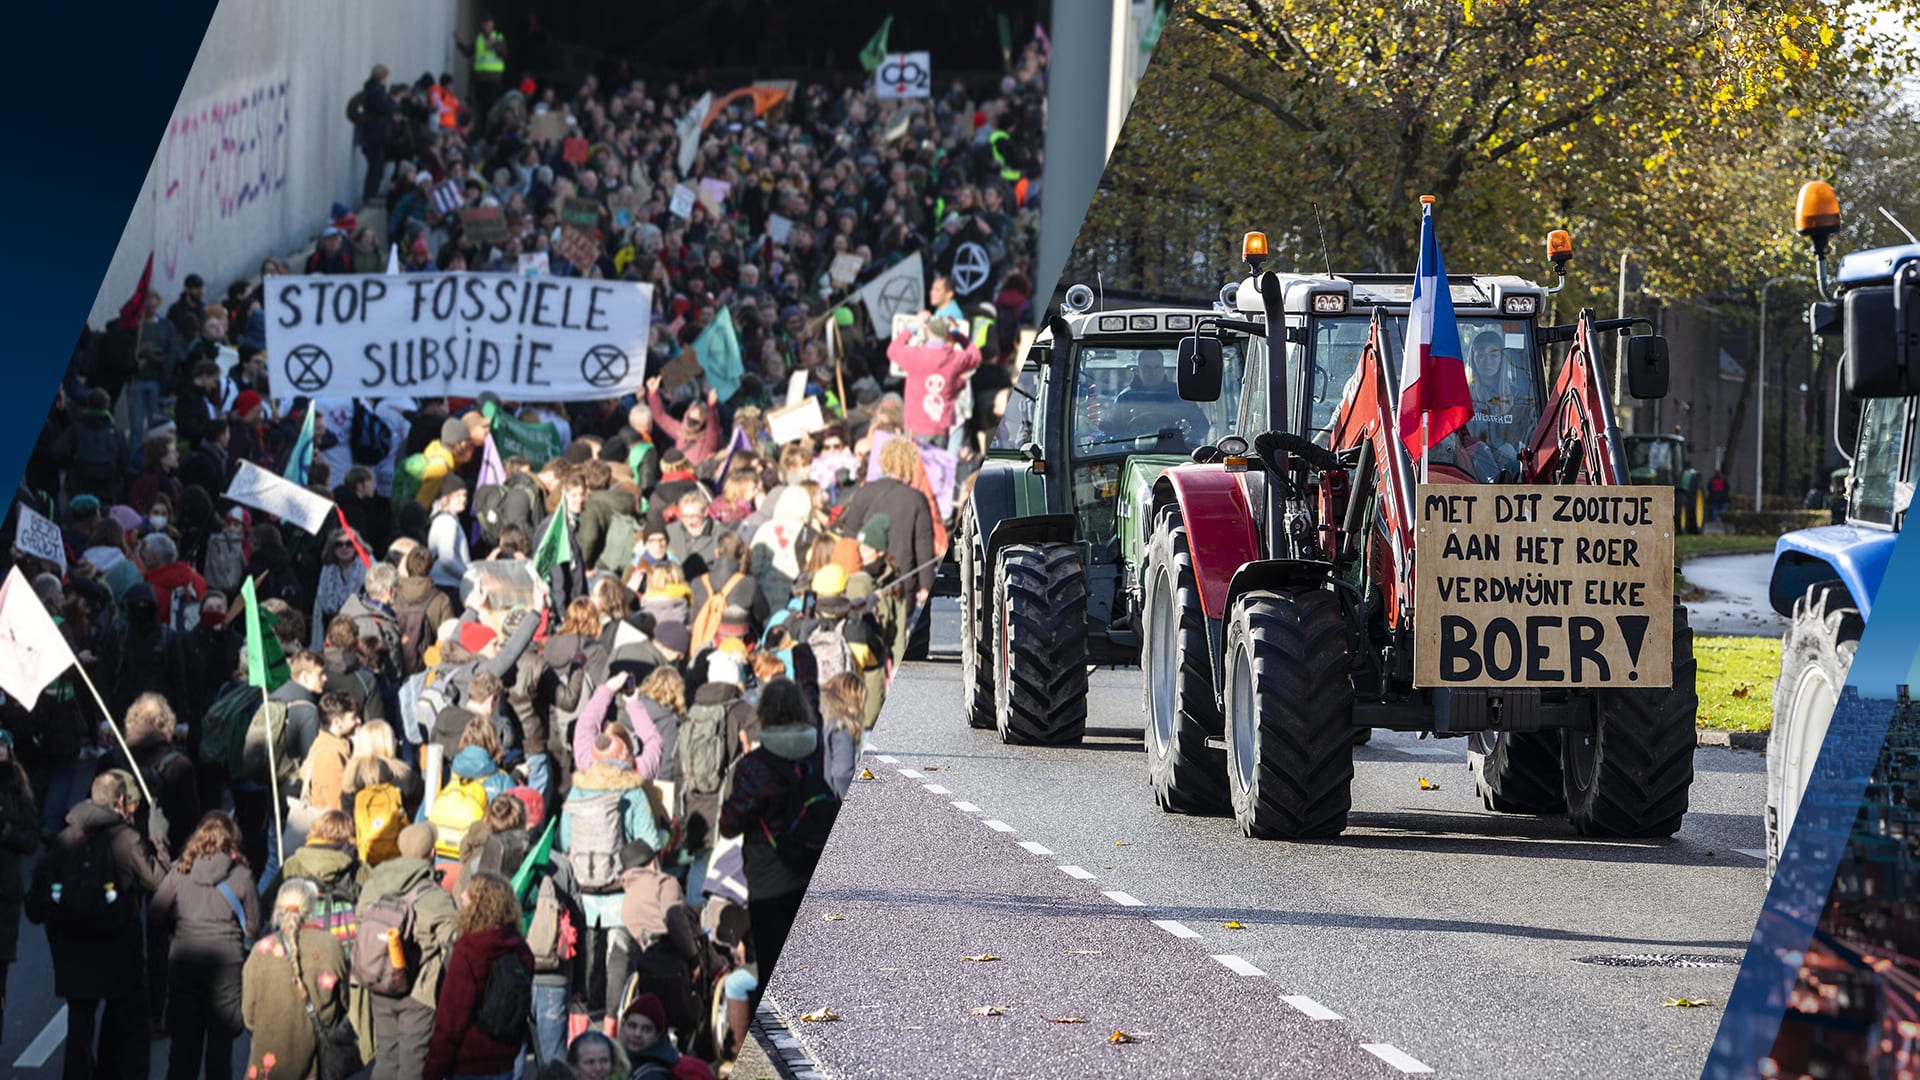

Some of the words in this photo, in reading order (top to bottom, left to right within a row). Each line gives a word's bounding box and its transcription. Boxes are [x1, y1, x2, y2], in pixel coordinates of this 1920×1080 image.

[278, 279, 387, 328] STOP
[407, 275, 614, 331] FOSSIELE
[1425, 494, 1477, 523] MET
[1495, 493, 1542, 523] DIT
[1552, 495, 1653, 526] ZOOITJE
[1442, 533, 1500, 561] AAN
[1516, 536, 1564, 565] HET
[1576, 537, 1640, 567] ROER
[1585, 580, 1645, 607] ELKE
[1440, 615, 1650, 683] BOER!
